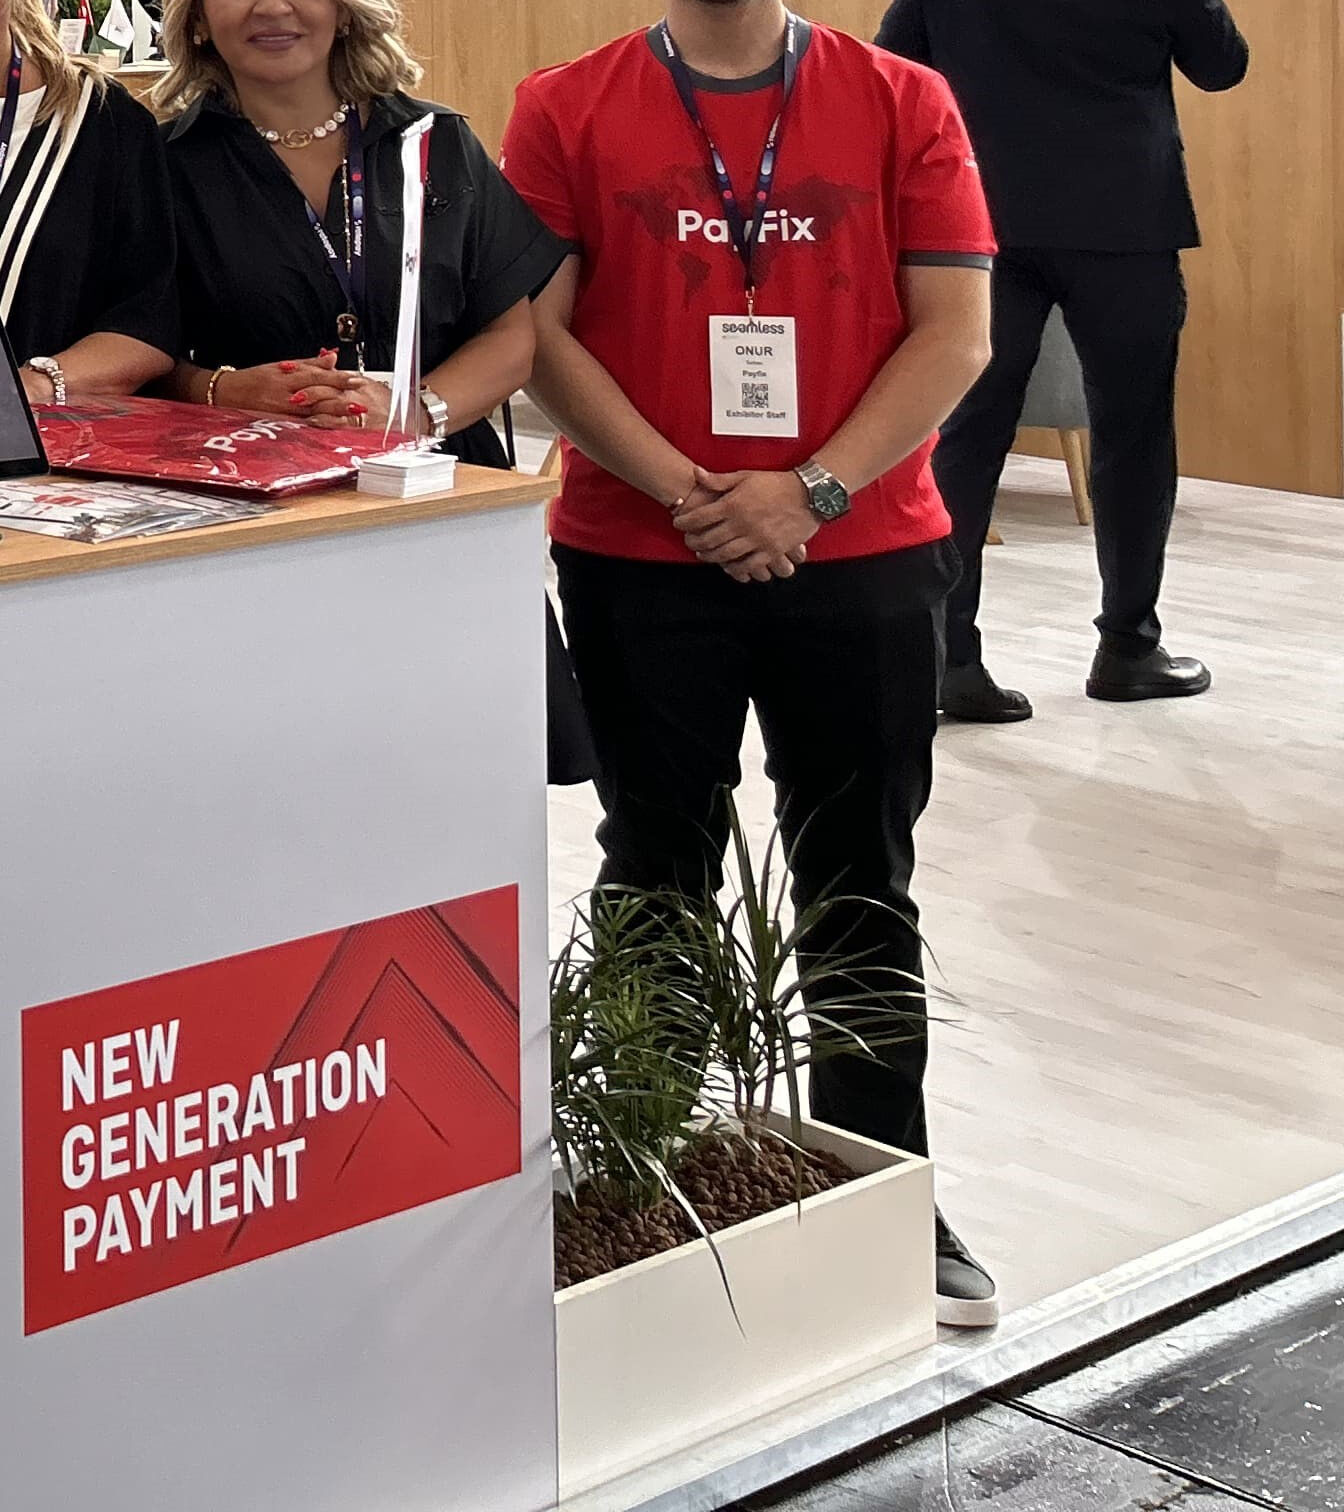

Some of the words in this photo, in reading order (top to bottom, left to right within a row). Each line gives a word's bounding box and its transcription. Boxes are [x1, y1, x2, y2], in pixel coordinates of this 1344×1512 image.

[722, 320, 784, 334] seamless
[736, 345, 773, 356] ONUR
[726, 409, 763, 418] Exhibitor
[766, 411, 786, 419] Staff
[62, 1019, 179, 1111] NEW
[62, 1039, 386, 1191] GENERATION
[63, 1137, 306, 1271] PAYMENT
